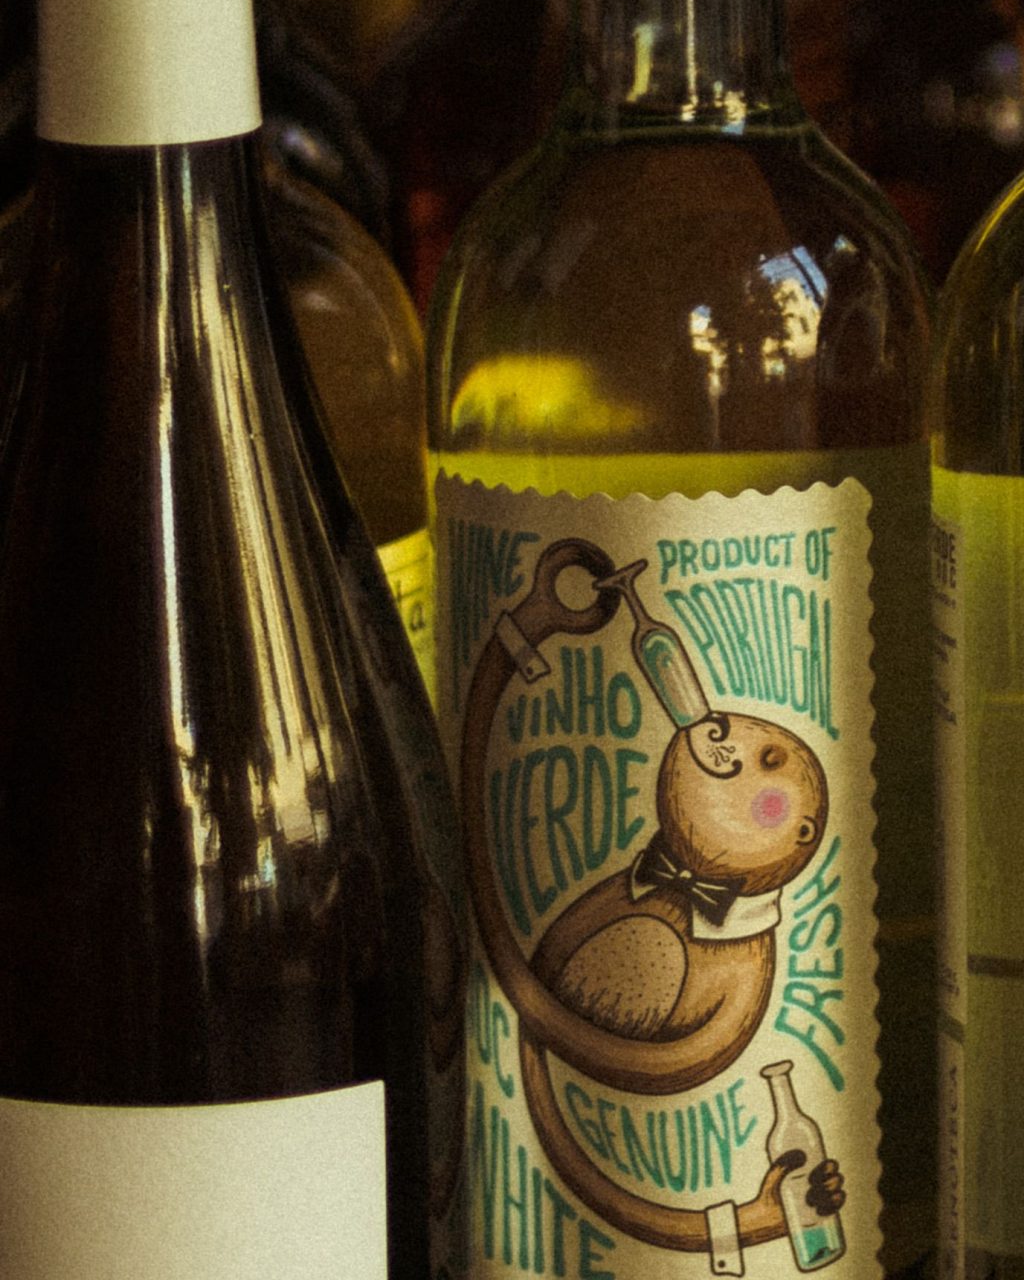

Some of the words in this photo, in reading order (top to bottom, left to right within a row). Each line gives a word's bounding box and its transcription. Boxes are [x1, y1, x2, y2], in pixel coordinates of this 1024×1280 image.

[448, 516, 541, 715] WINE
[656, 530, 796, 585] PRODUCT
[805, 526, 837, 581] OF
[506, 645, 643, 744] VINHO
[664, 577, 839, 741] PORTUGAL
[490, 745, 650, 937] VERDE
[774, 835, 845, 1093] FRESH
[564, 1078, 758, 1194] GENUINE
